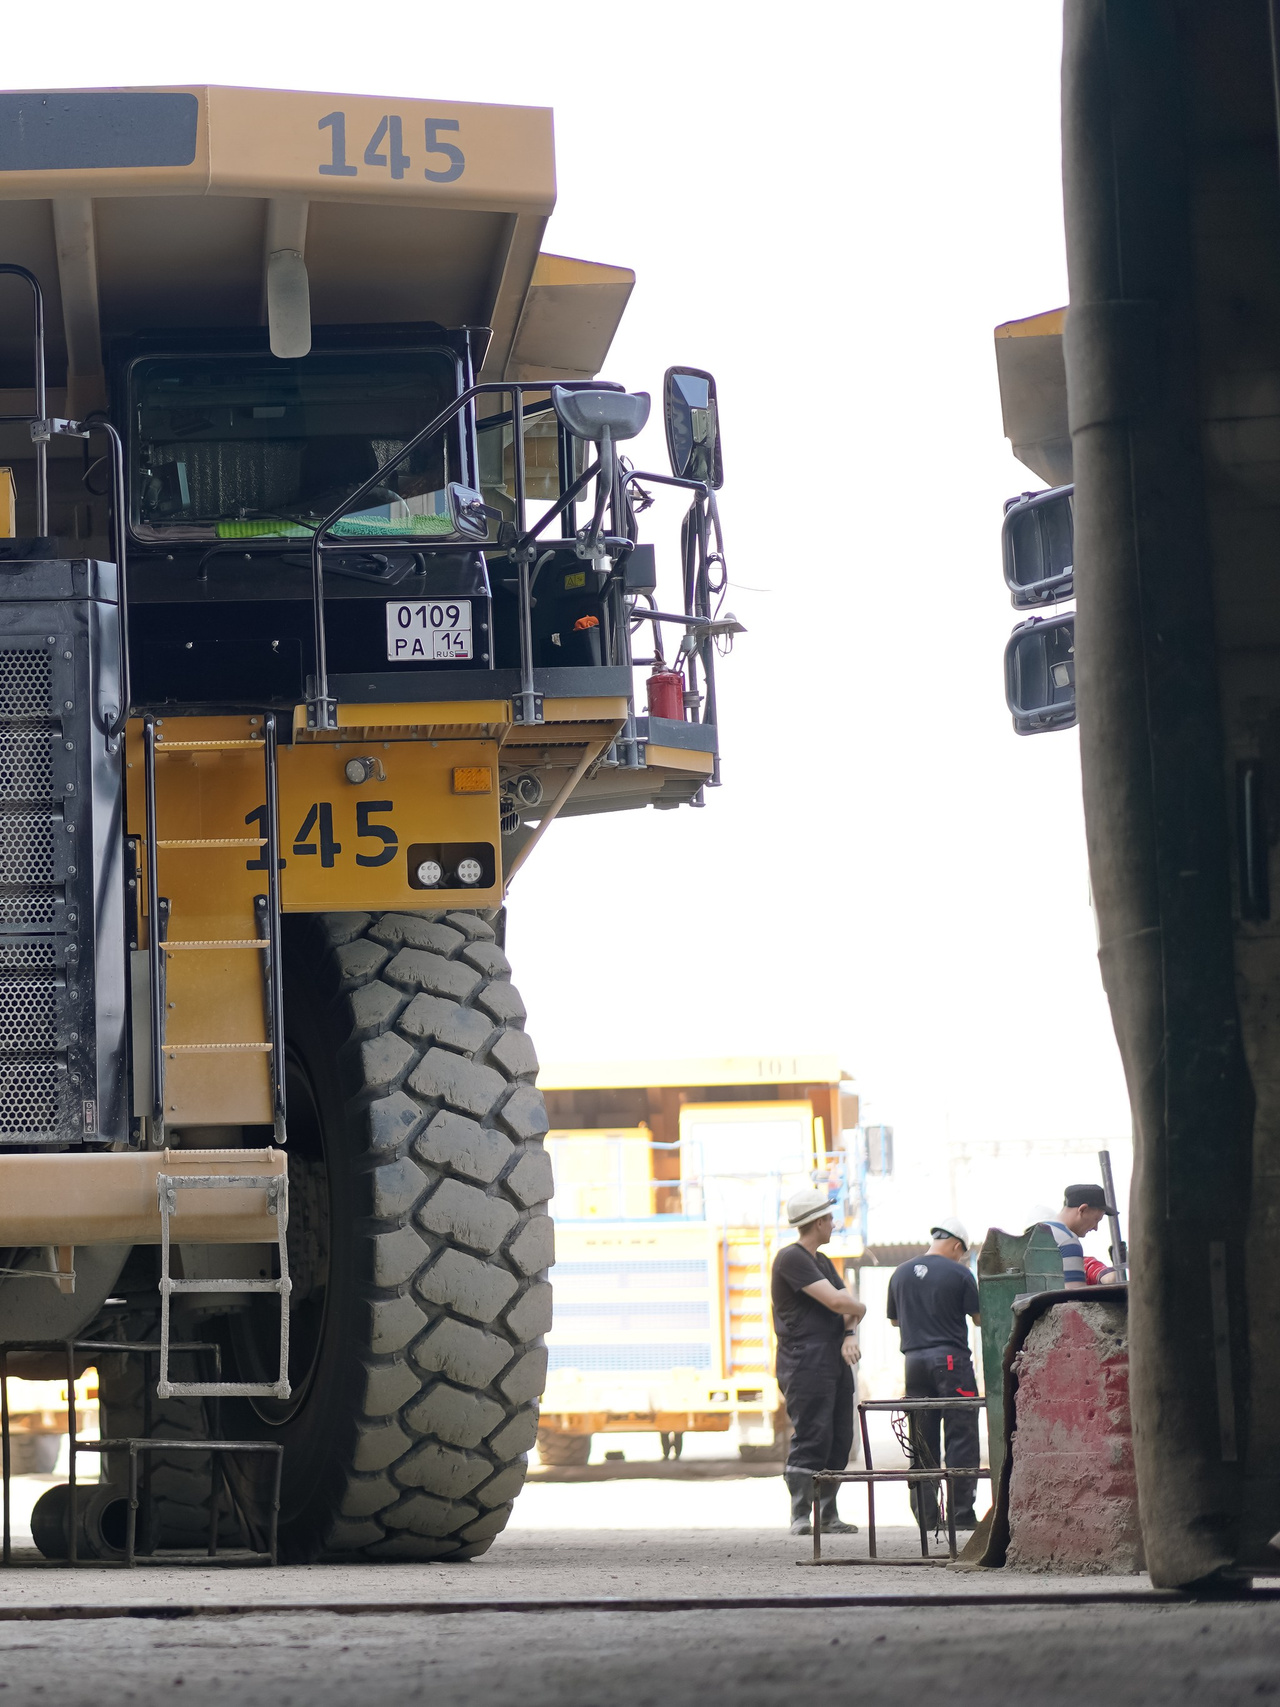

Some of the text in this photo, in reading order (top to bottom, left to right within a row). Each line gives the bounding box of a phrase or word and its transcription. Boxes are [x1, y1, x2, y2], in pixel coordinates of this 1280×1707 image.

[318, 111, 465, 183] 145
[397, 605, 460, 628] 0109
[441, 632, 464, 650] 14
[245, 800, 399, 870] 145
